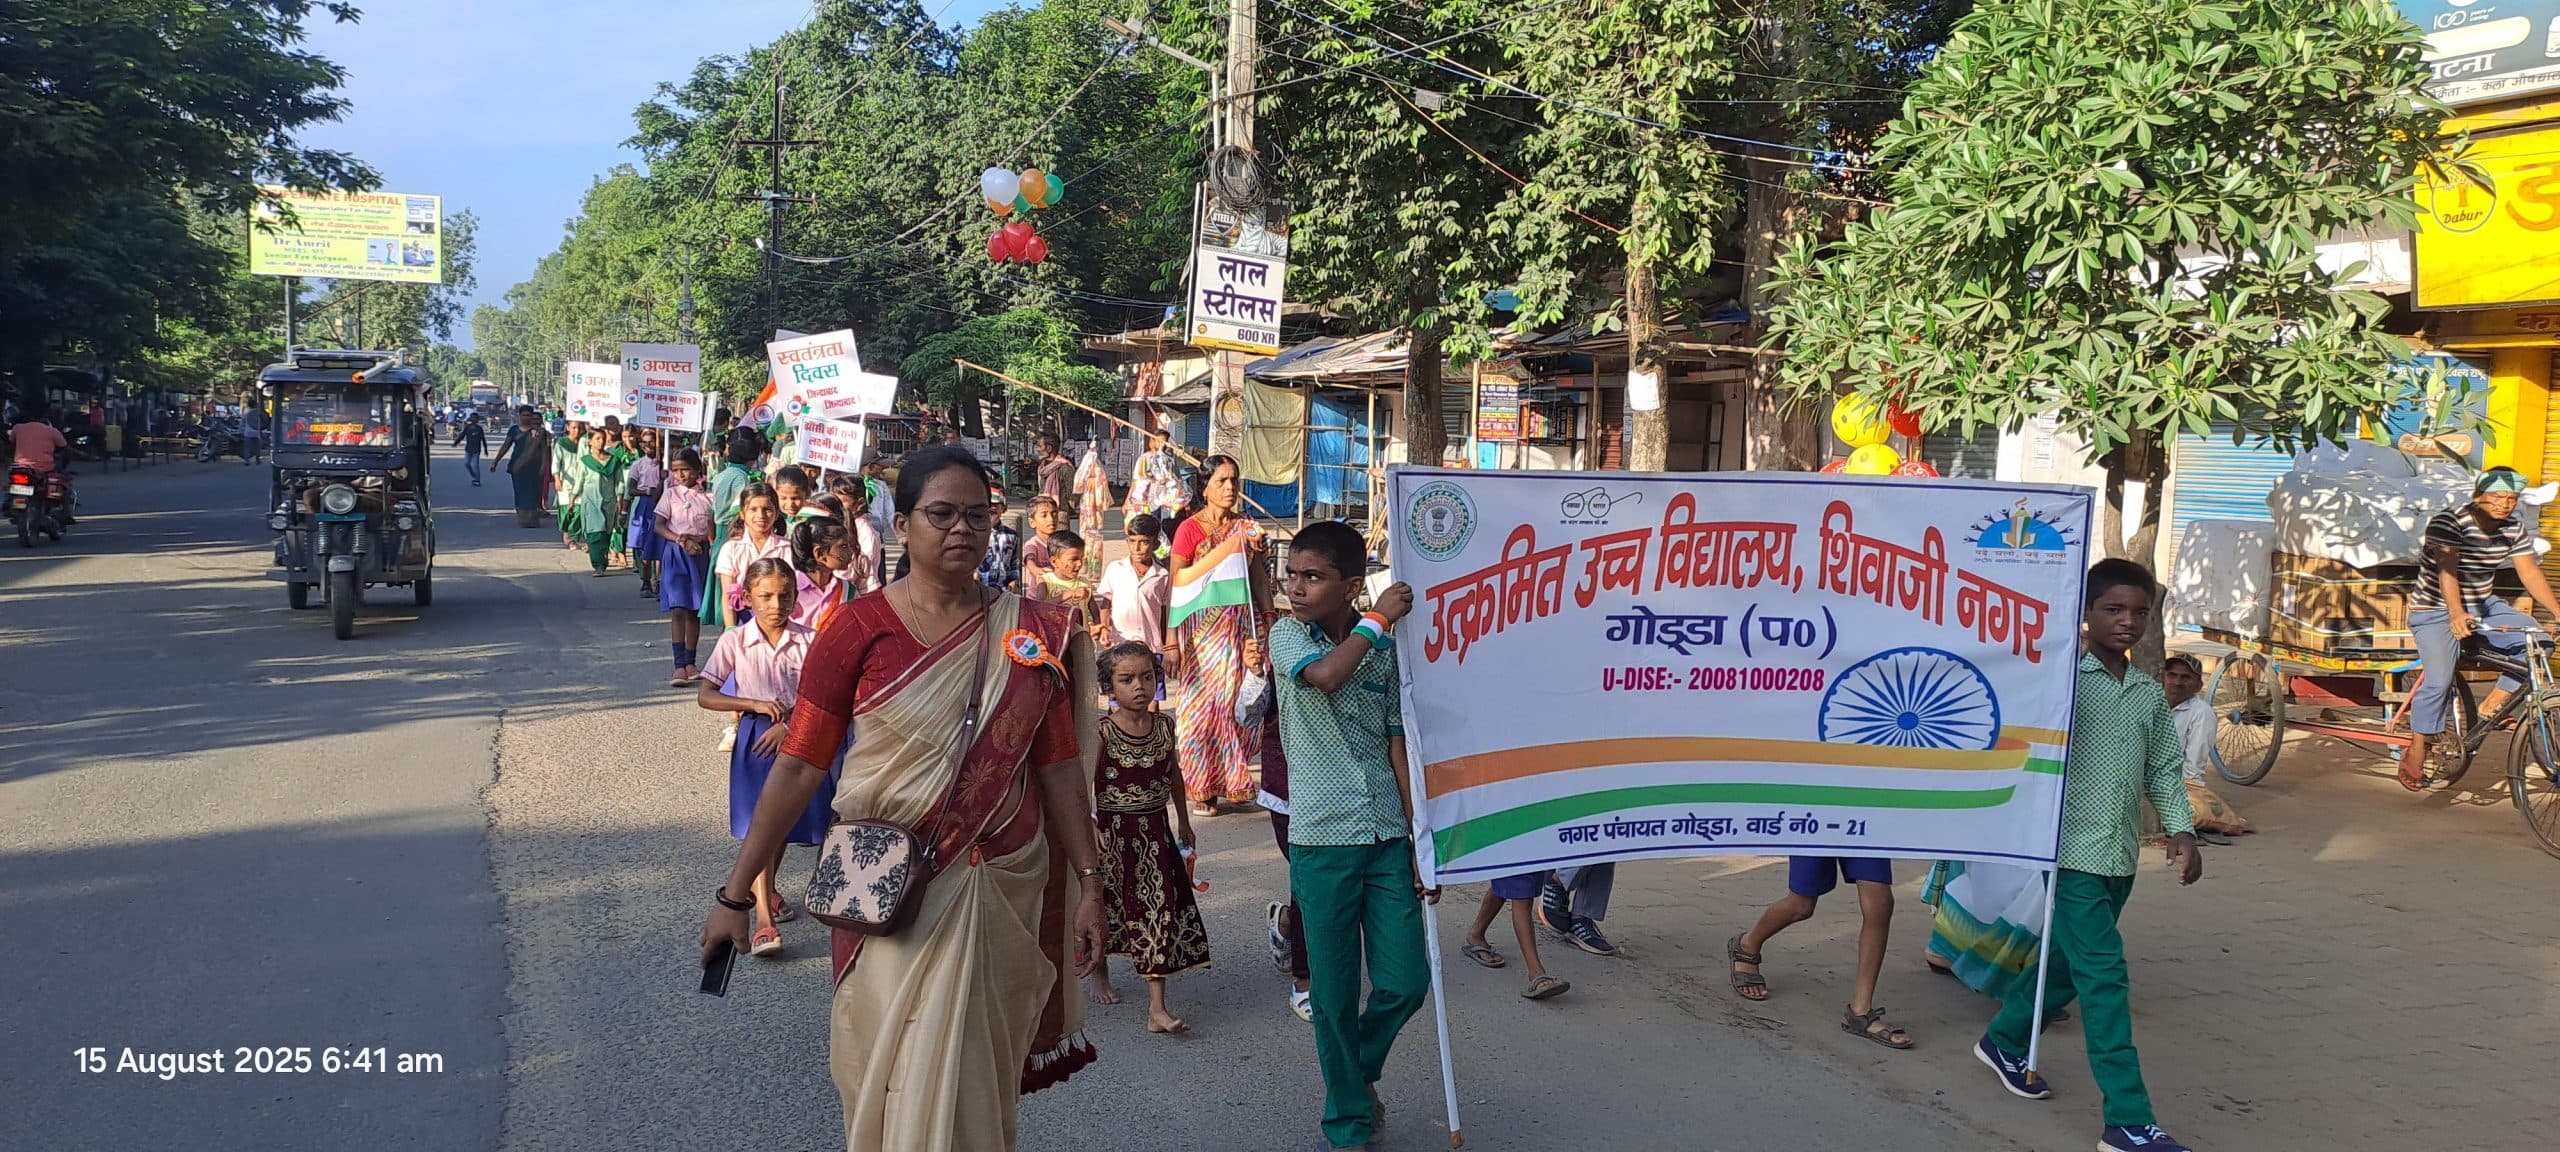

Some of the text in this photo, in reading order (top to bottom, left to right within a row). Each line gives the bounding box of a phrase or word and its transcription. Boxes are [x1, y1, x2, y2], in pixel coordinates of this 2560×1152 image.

[344, 193, 400, 206] HOSPITAL
[2442, 209, 2484, 225] Dabur
[1217, 256, 1269, 288] लाल
[1202, 283, 1277, 324] स्टीलस
[1238, 328, 1276, 345] 600 XR
[776, 341, 845, 365] स्वतंत्रता
[626, 358, 693, 373] 15 अगस्त
[792, 363, 840, 384] दिवस
[572, 374, 583, 384] 15
[826, 425, 838, 436] की
[1424, 491, 2050, 667] उत्क्रमित उच्च विद्यालय, शिवाजी नगर
[1602, 667, 1826, 692] U-DISE:- 20081000208
[1558, 823, 1600, 845] नगर
[1603, 816, 1666, 840] पंचायत
[1746, 811, 1786, 836] वार्ड
[1847, 818, 1867, 836] 21
